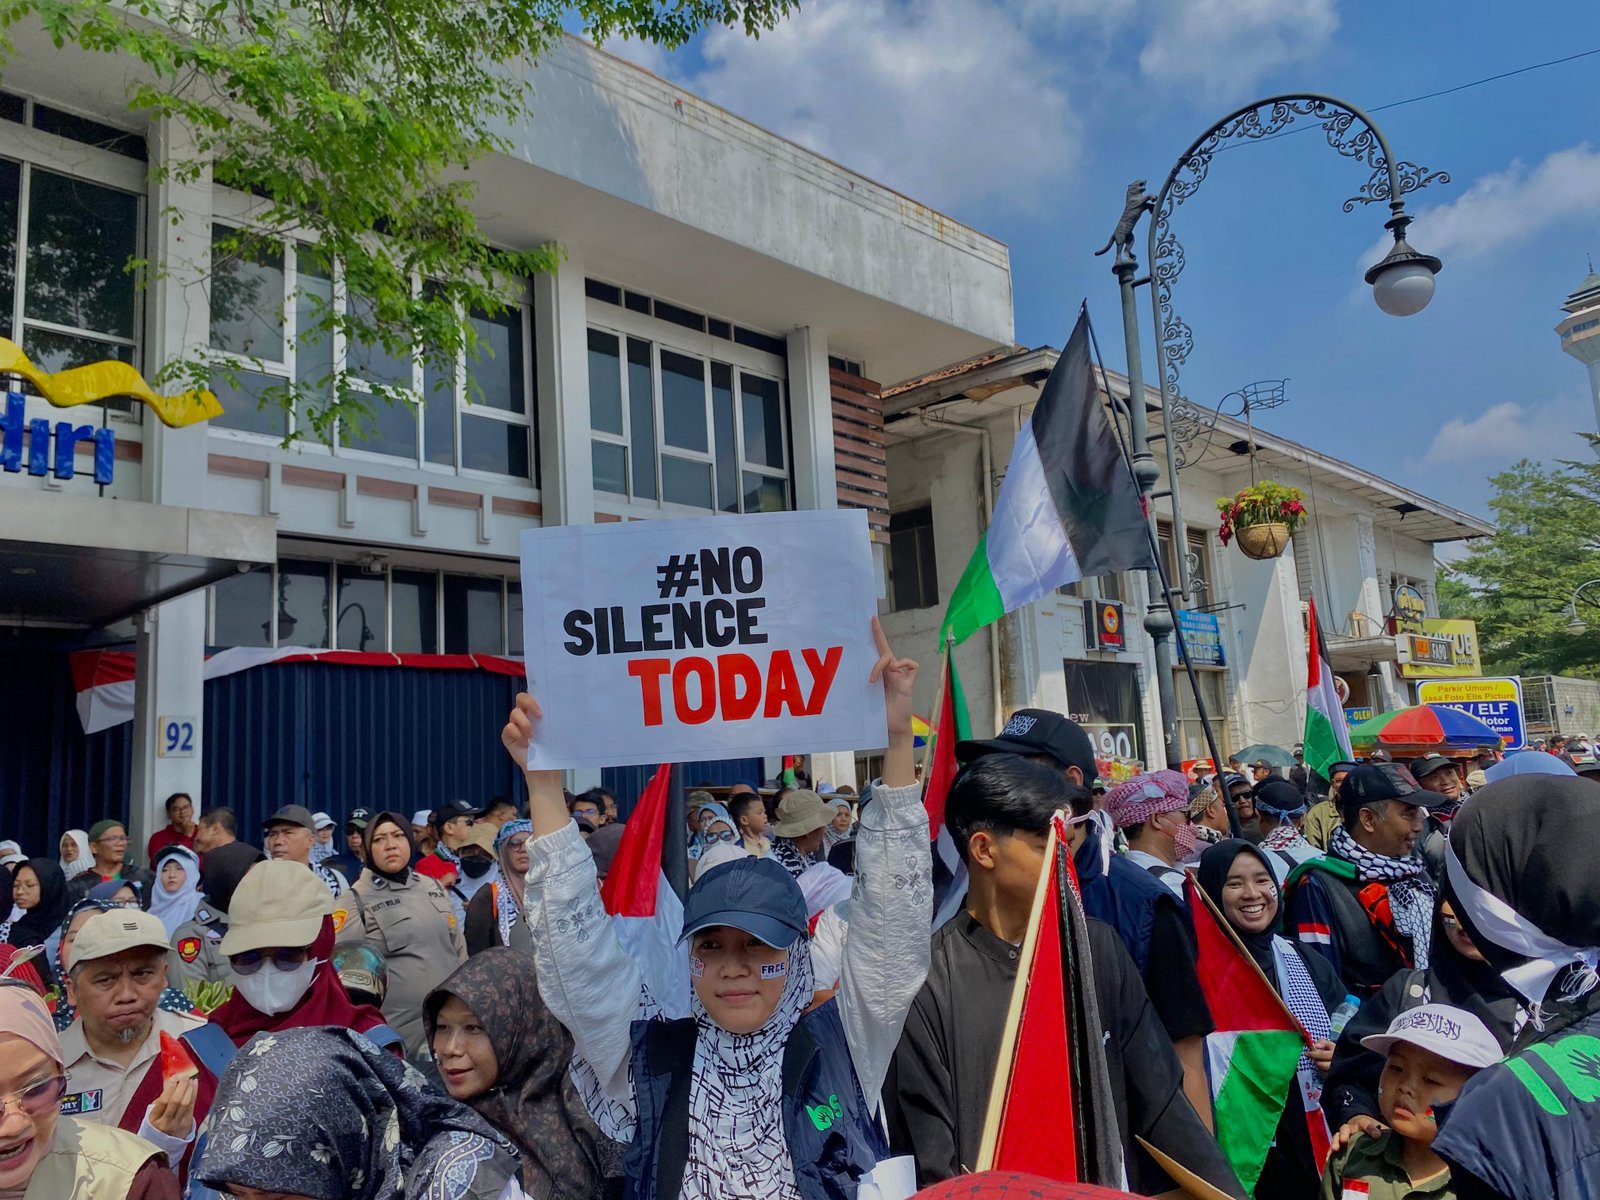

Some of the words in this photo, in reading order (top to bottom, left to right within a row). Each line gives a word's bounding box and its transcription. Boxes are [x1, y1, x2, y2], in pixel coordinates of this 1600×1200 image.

[656, 546, 763, 599] #NO
[563, 597, 768, 656] SILENCE
[627, 646, 844, 727] TODAY
[1465, 684, 1493, 692] Umum
[1484, 692, 1515, 700] Picture
[1478, 702, 1509, 715] ELF
[1353, 710, 1371, 721] OLEH
[166, 722, 194, 752] 92
[762, 962, 785, 974] FREE
